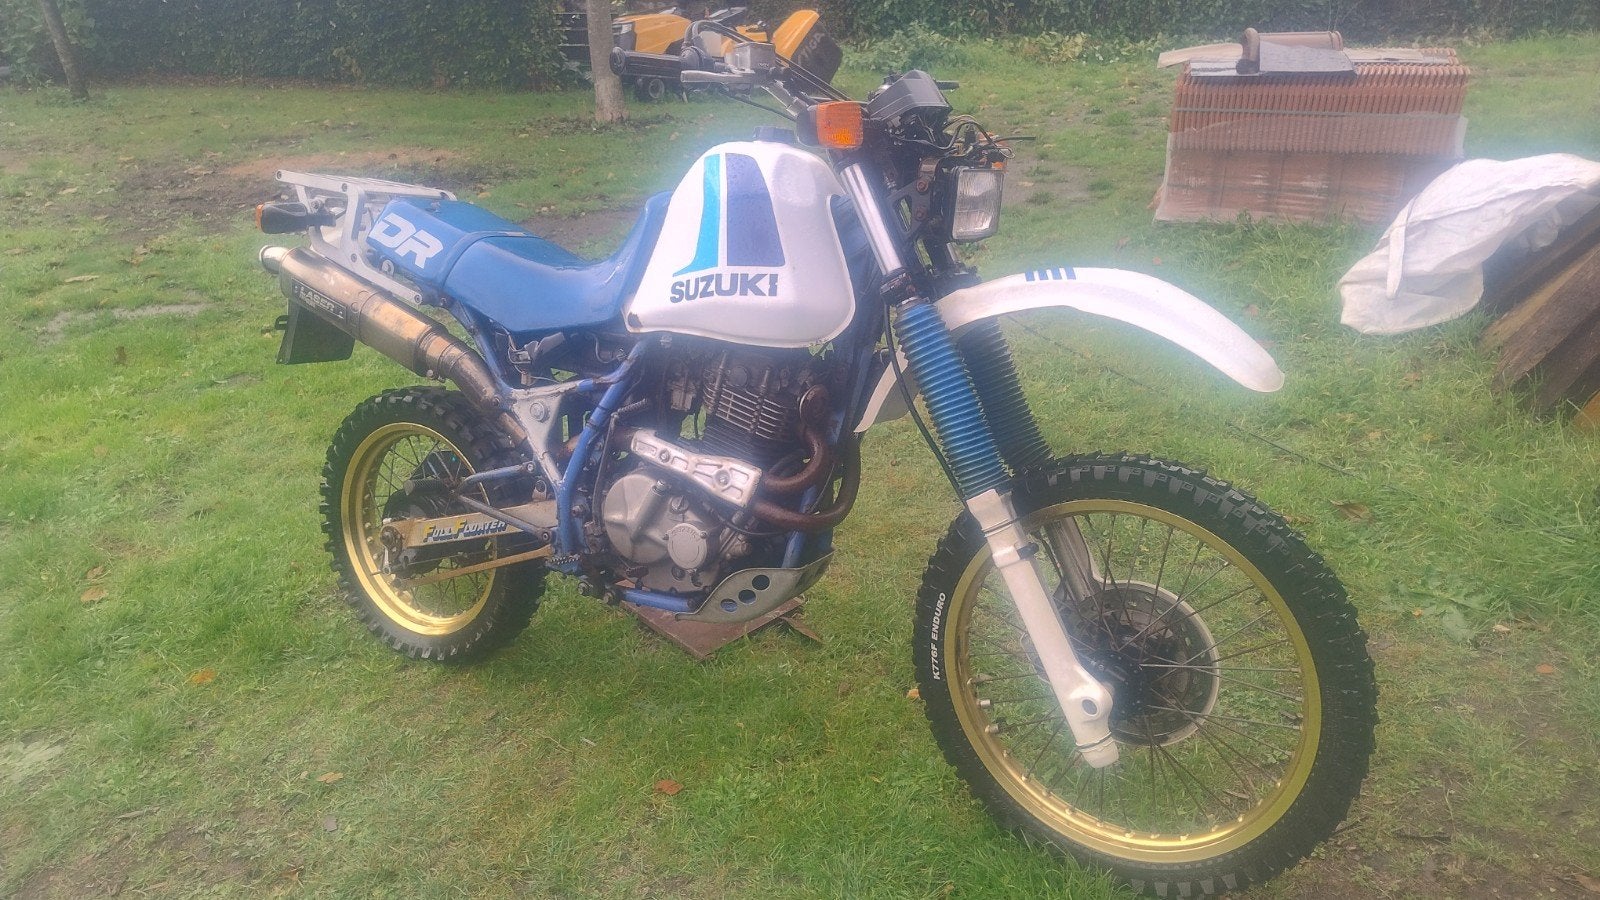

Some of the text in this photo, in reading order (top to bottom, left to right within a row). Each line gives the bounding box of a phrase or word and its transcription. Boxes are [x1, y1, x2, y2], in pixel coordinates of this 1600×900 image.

[369, 213, 443, 269] DR
[300, 286, 335, 312] LASER
[670, 273, 778, 303] SUZUKI
[454, 519, 507, 538] FLOATER
[930, 592, 946, 680] K776F ENDURO
